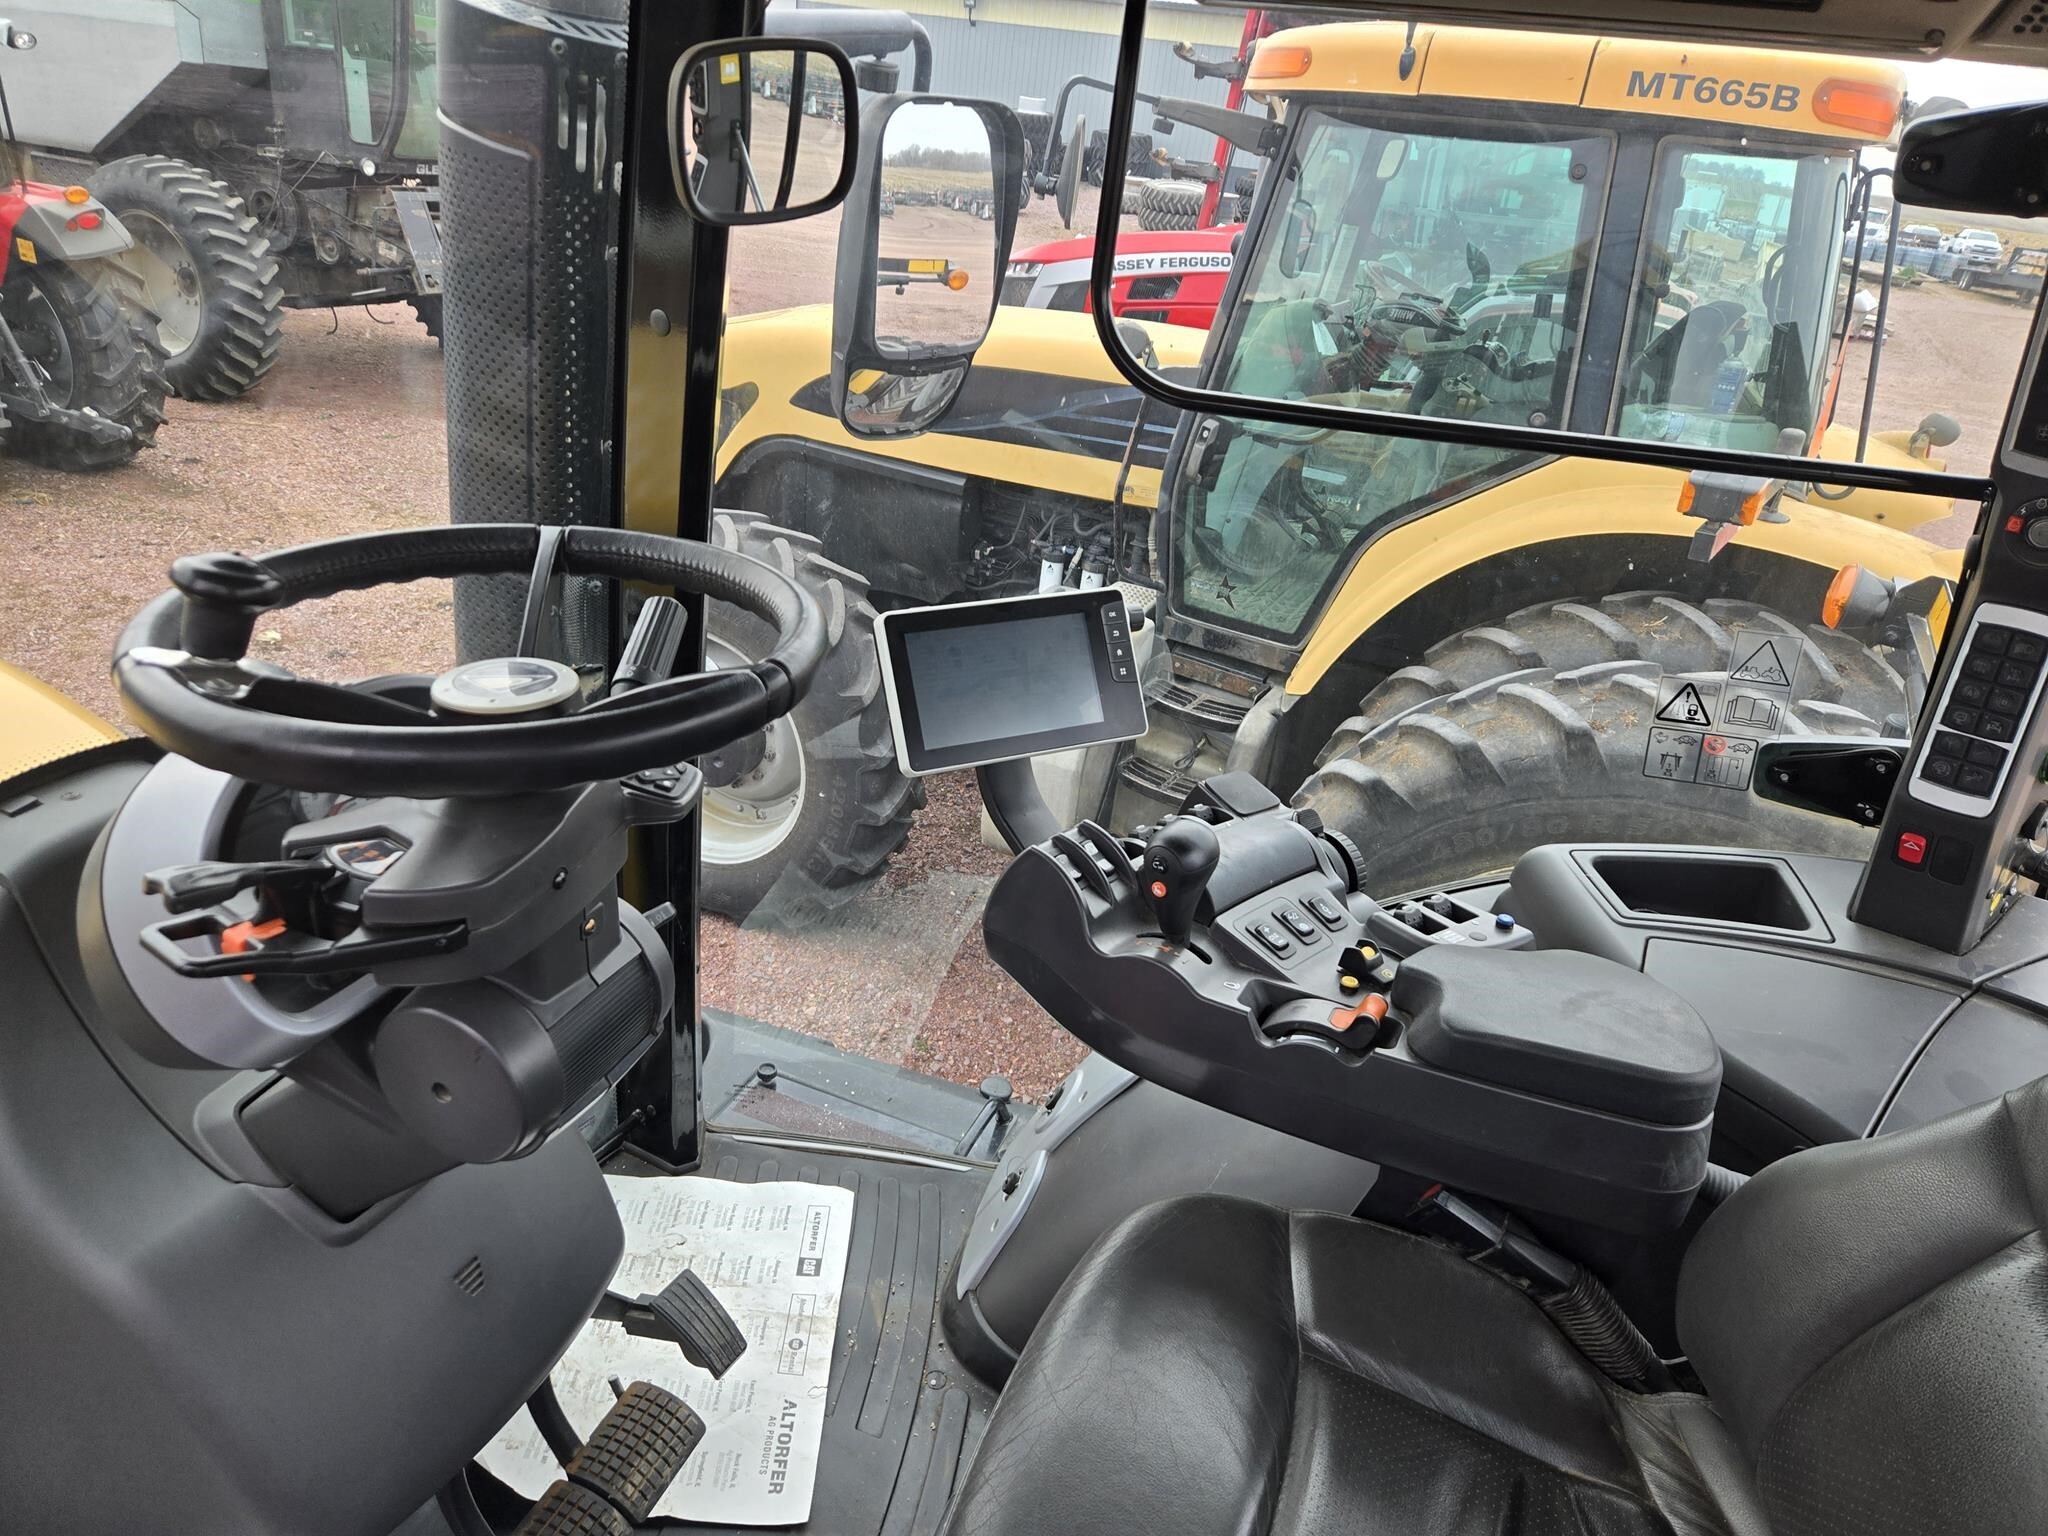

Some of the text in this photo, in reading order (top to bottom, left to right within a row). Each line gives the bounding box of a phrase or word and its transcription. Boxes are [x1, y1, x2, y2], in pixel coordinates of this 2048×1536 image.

[1626, 71, 1801, 112] MT665B
[416, 163, 440, 175] GLE
[1111, 256, 1232, 272] SSEY FERGUSO
[802, 1211, 822, 1275] ALTORFER CAT
[758, 1415, 777, 1476] AG PRODUCTS
[768, 1398, 798, 1496] ALTORFER
